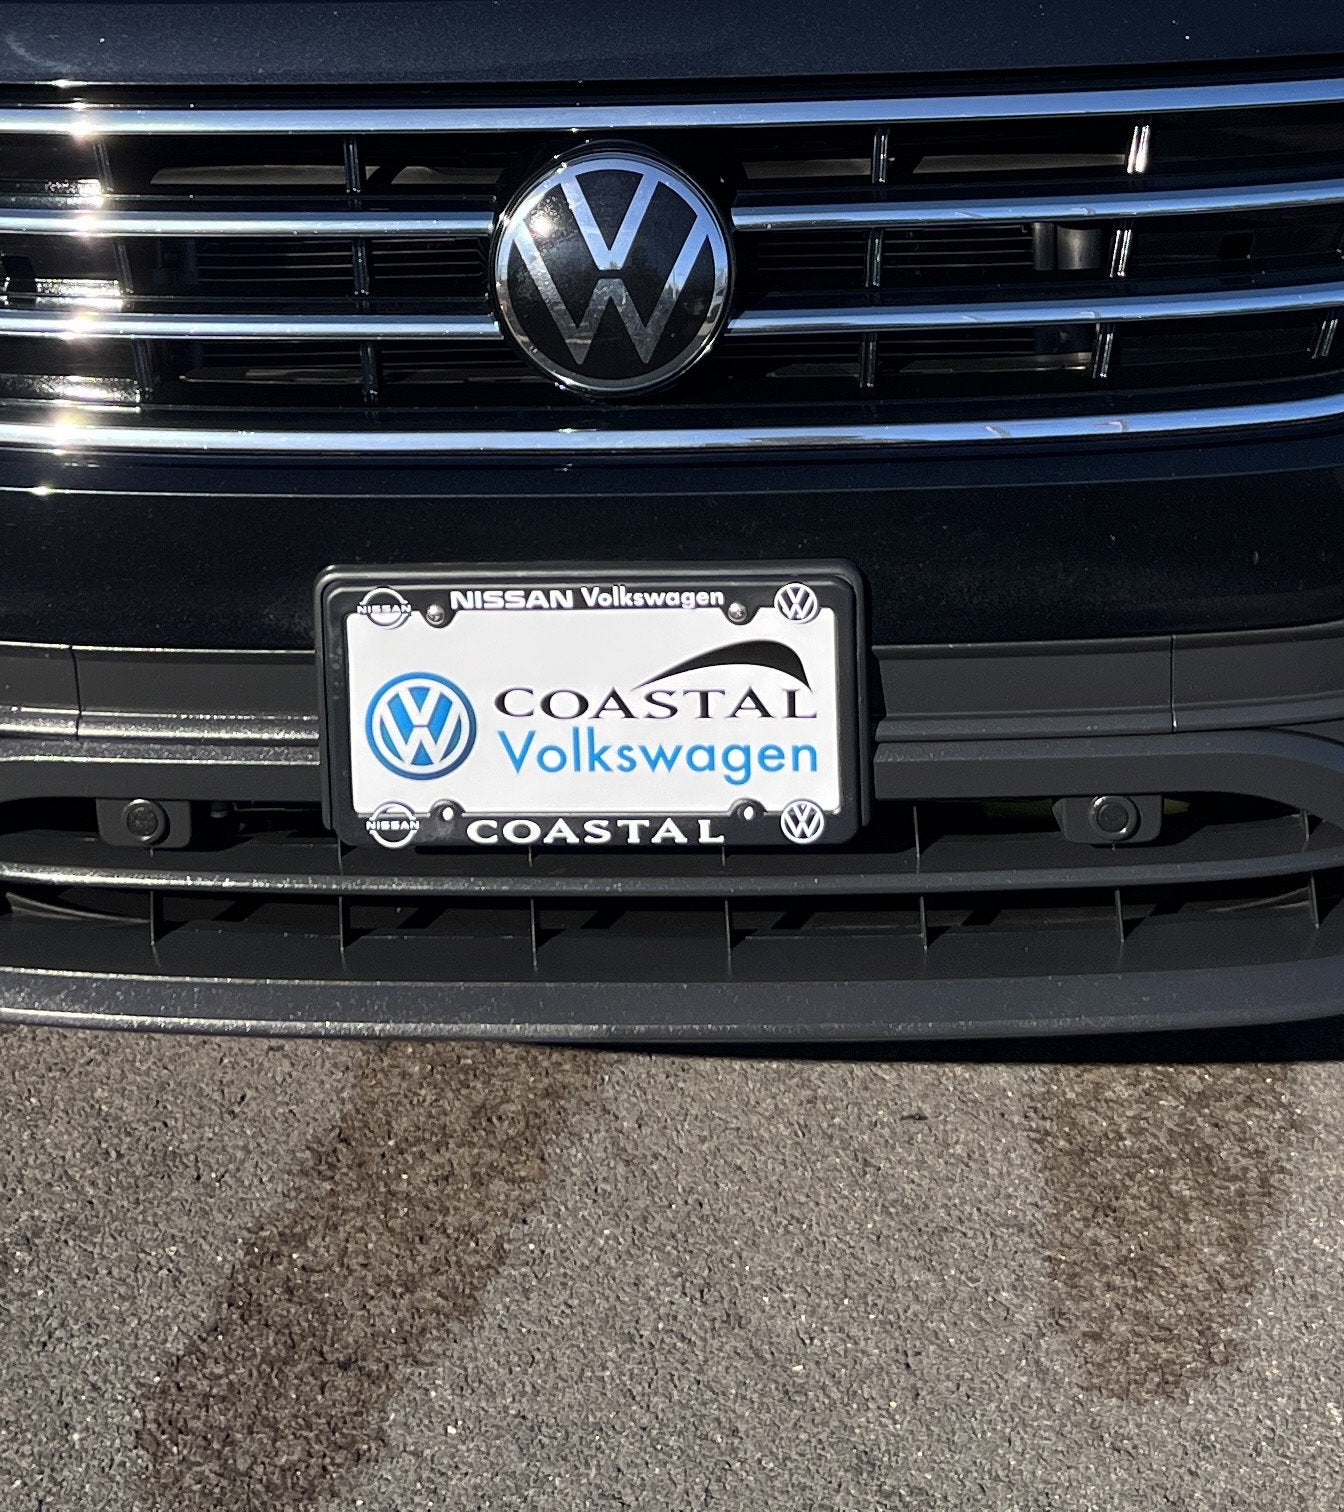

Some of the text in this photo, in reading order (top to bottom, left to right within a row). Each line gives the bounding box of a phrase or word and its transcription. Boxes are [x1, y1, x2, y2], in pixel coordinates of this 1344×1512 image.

[357, 604, 412, 614] NISSAN
[450, 586, 725, 610] NISSAN Volkswagen
[494, 686, 818, 719] COASTAL
[498, 726, 818, 785] Volkswagen
[365, 820, 420, 831] NISSAN
[466, 817, 725, 844] COASTAL
